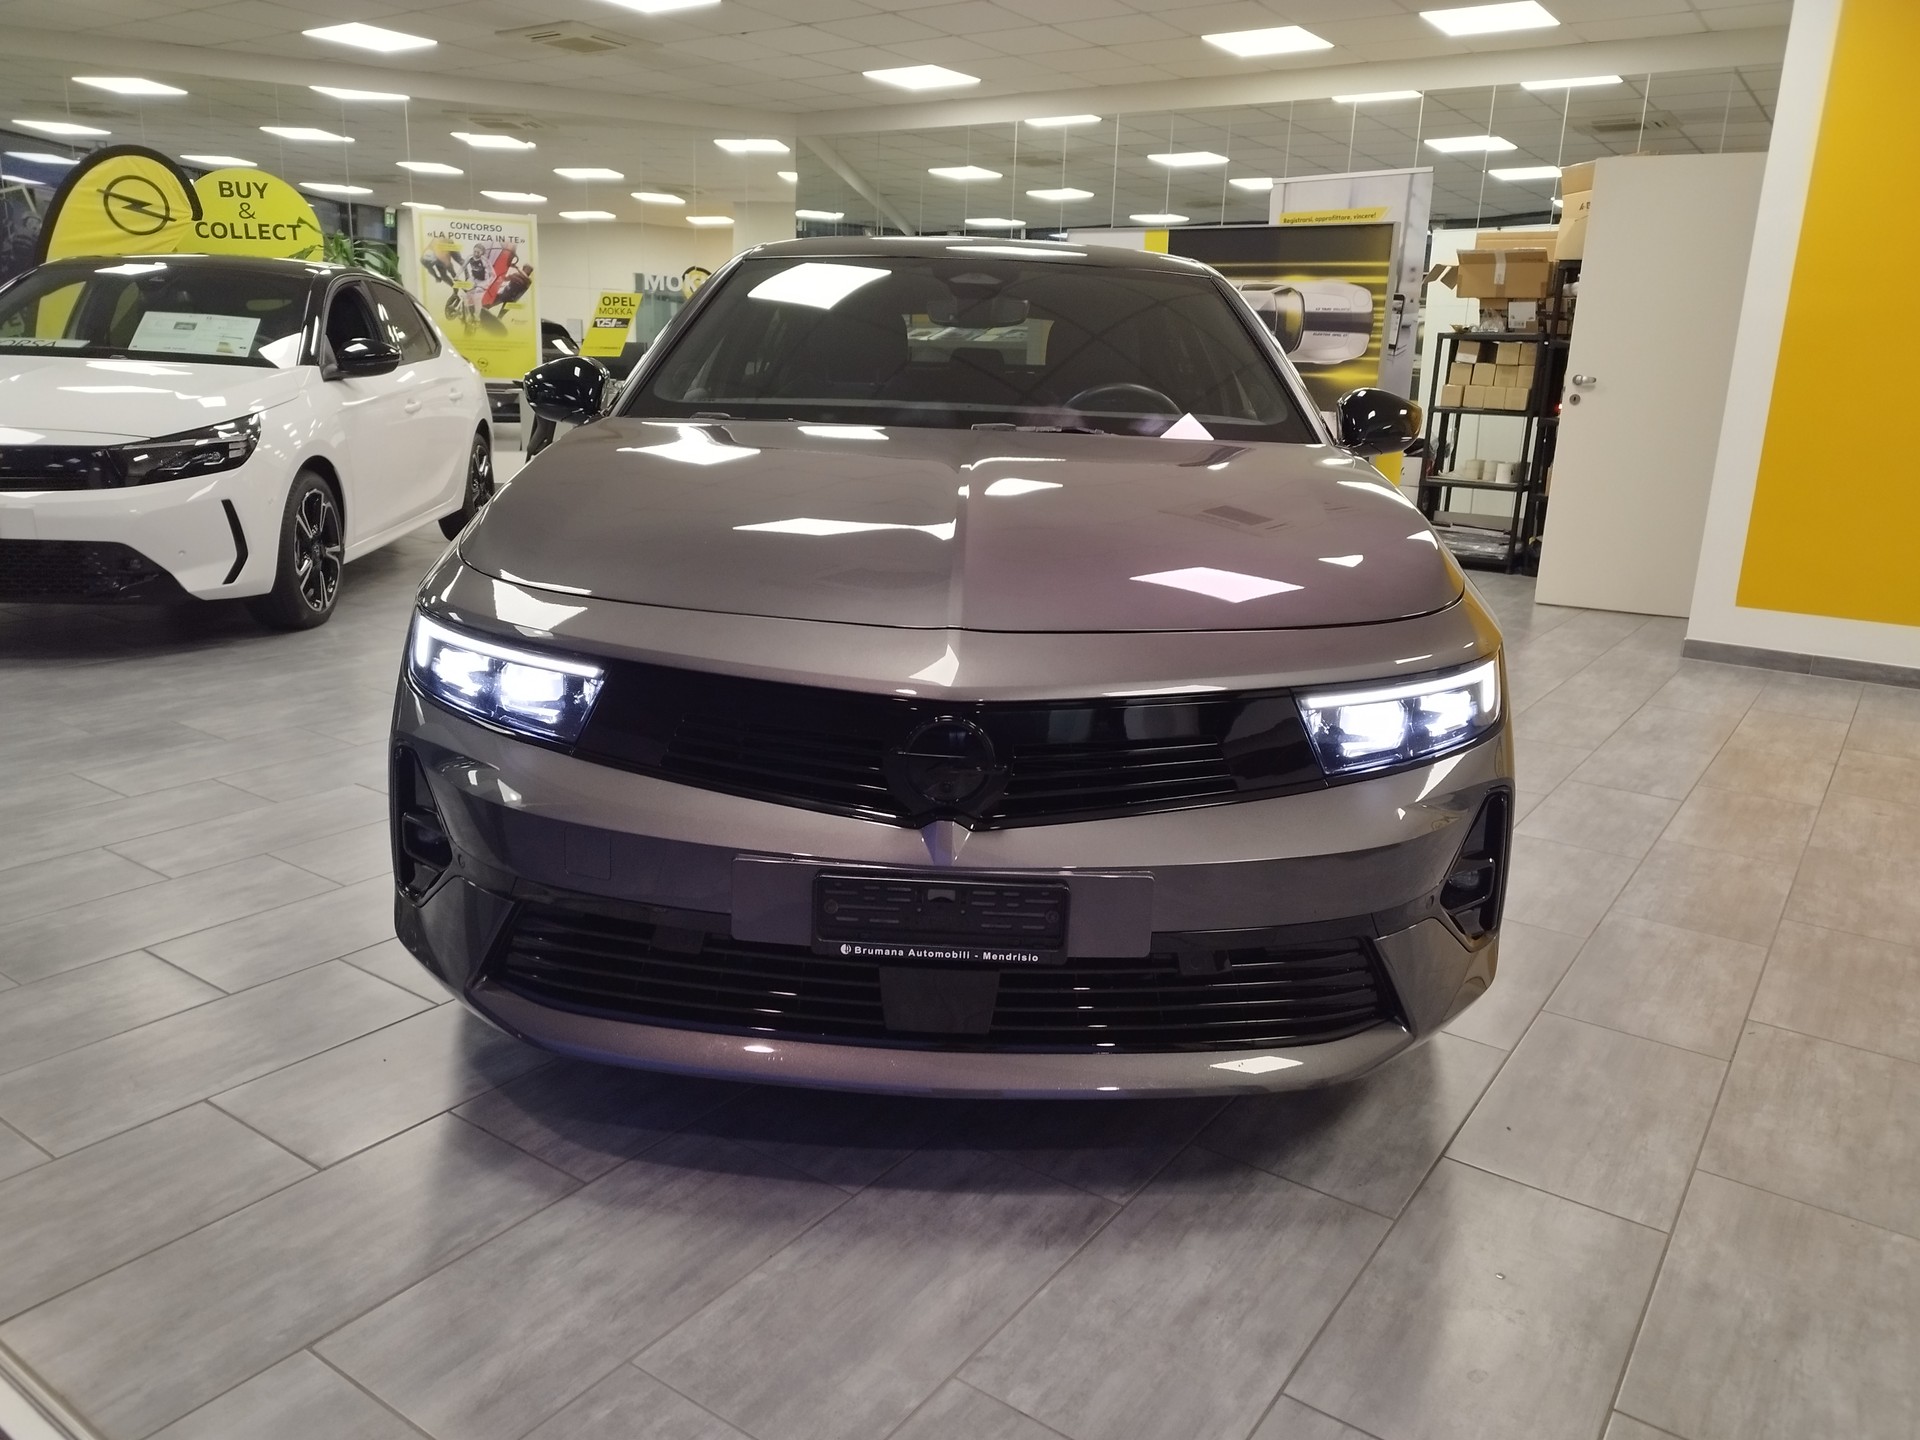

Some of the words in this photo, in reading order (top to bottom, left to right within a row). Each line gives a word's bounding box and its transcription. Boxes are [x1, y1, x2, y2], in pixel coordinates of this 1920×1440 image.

[218, 181, 268, 199] BUY
[239, 202, 256, 219] &
[195, 221, 301, 240] COLLECT
[450, 221, 503, 232] CONCORSO
[448, 232, 493, 242] POTENZA
[644, 273, 704, 293] MOK
[602, 296, 636, 307] OPEL
[598, 307, 633, 315] MOKKA
[855, 946, 904, 957] Brumana
[908, 948, 970, 959] Automobili
[983, 952, 1039, 962] Mendrisio
